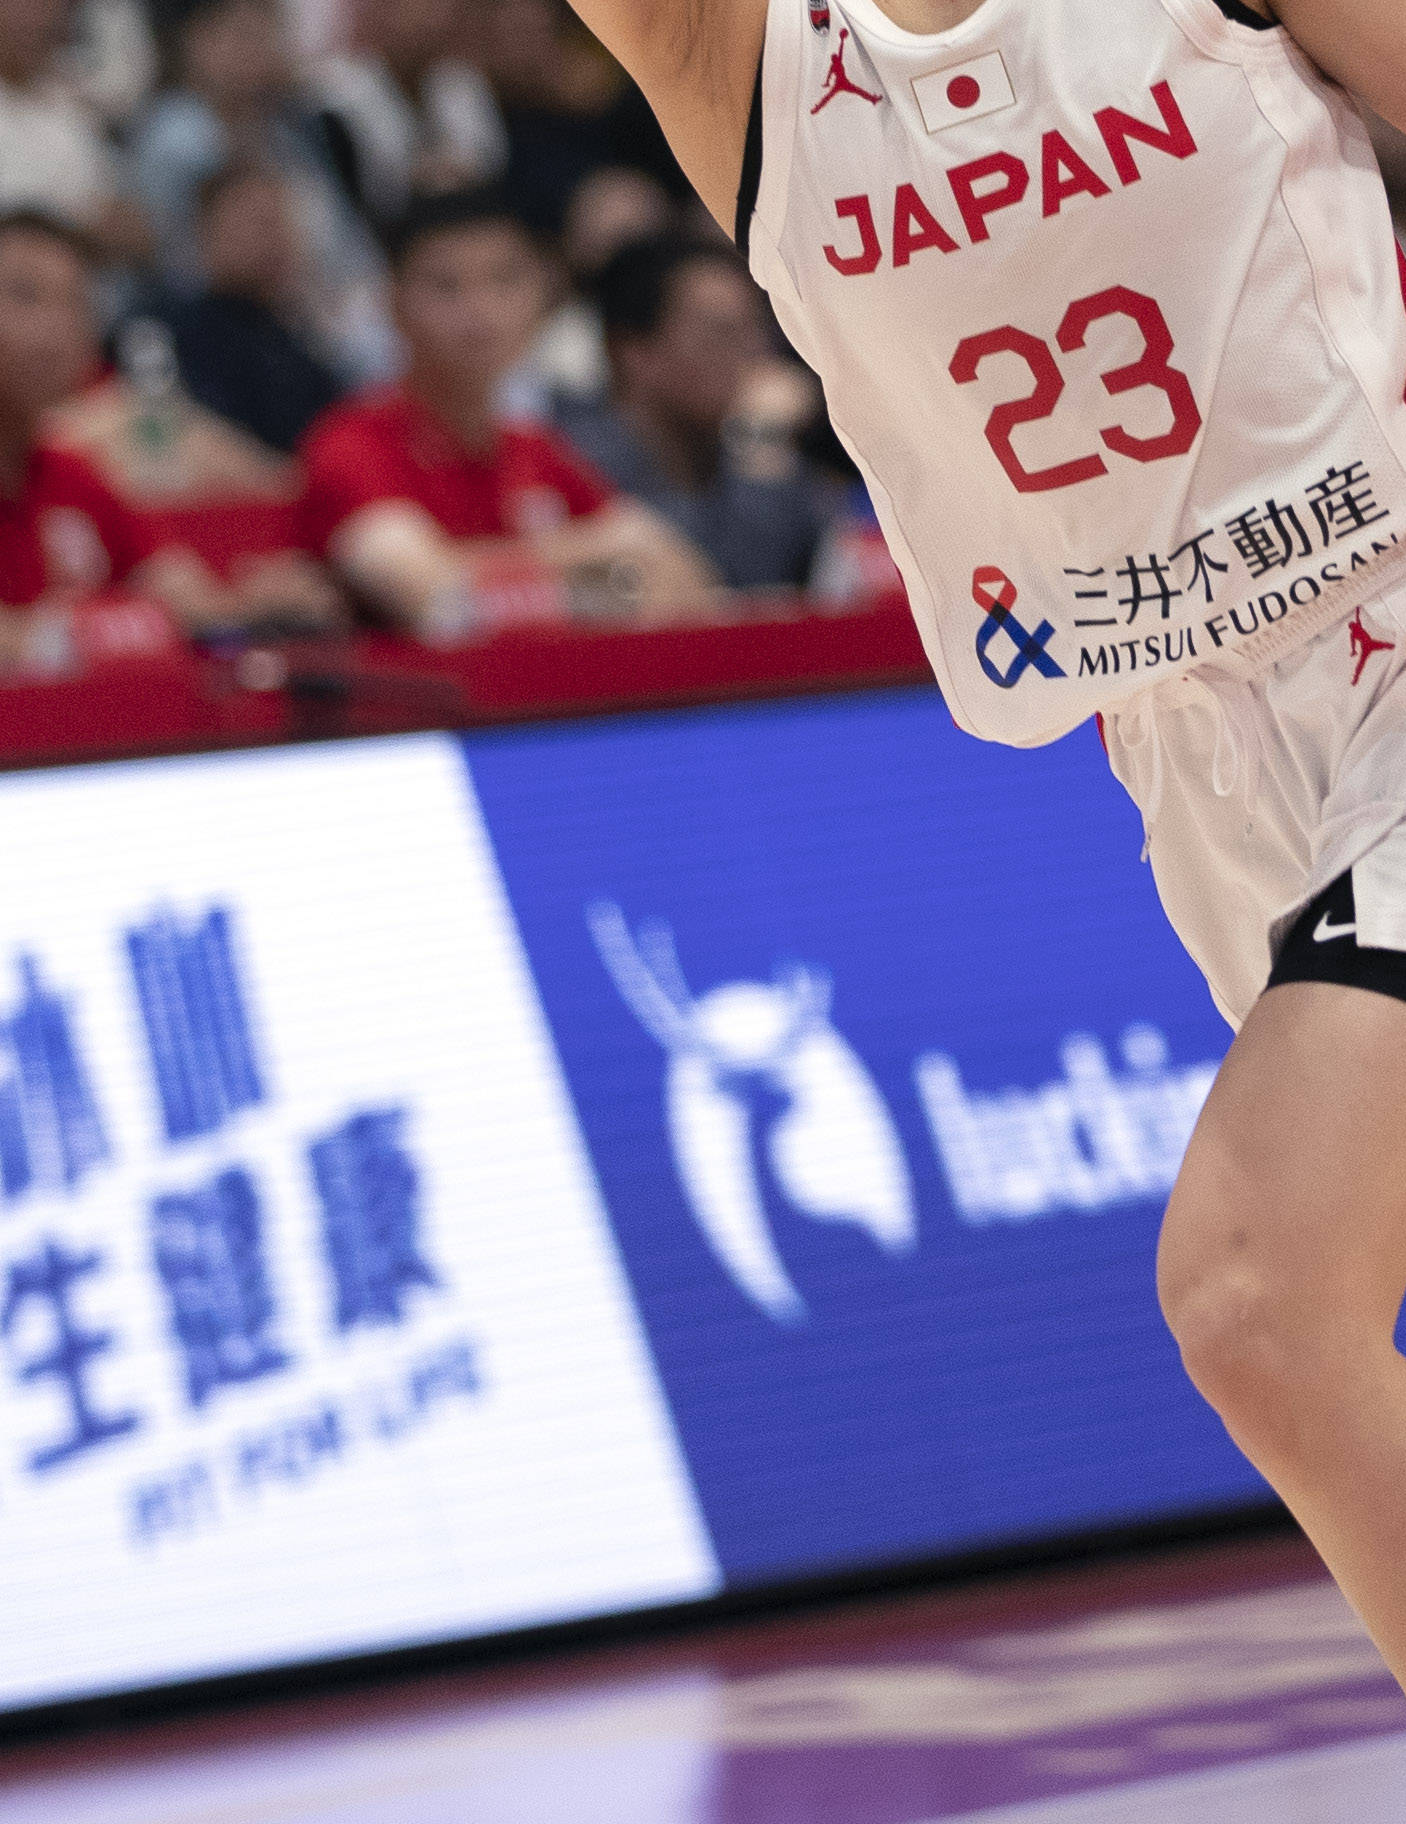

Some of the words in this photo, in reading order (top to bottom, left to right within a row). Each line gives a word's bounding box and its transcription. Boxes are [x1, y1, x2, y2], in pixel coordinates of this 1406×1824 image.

[822, 79, 1198, 277] JAPAN
[948, 284, 1203, 494] 23
[1062, 459, 1390, 627] 三井不動産
[1077, 627, 1198, 678] MITSUI
